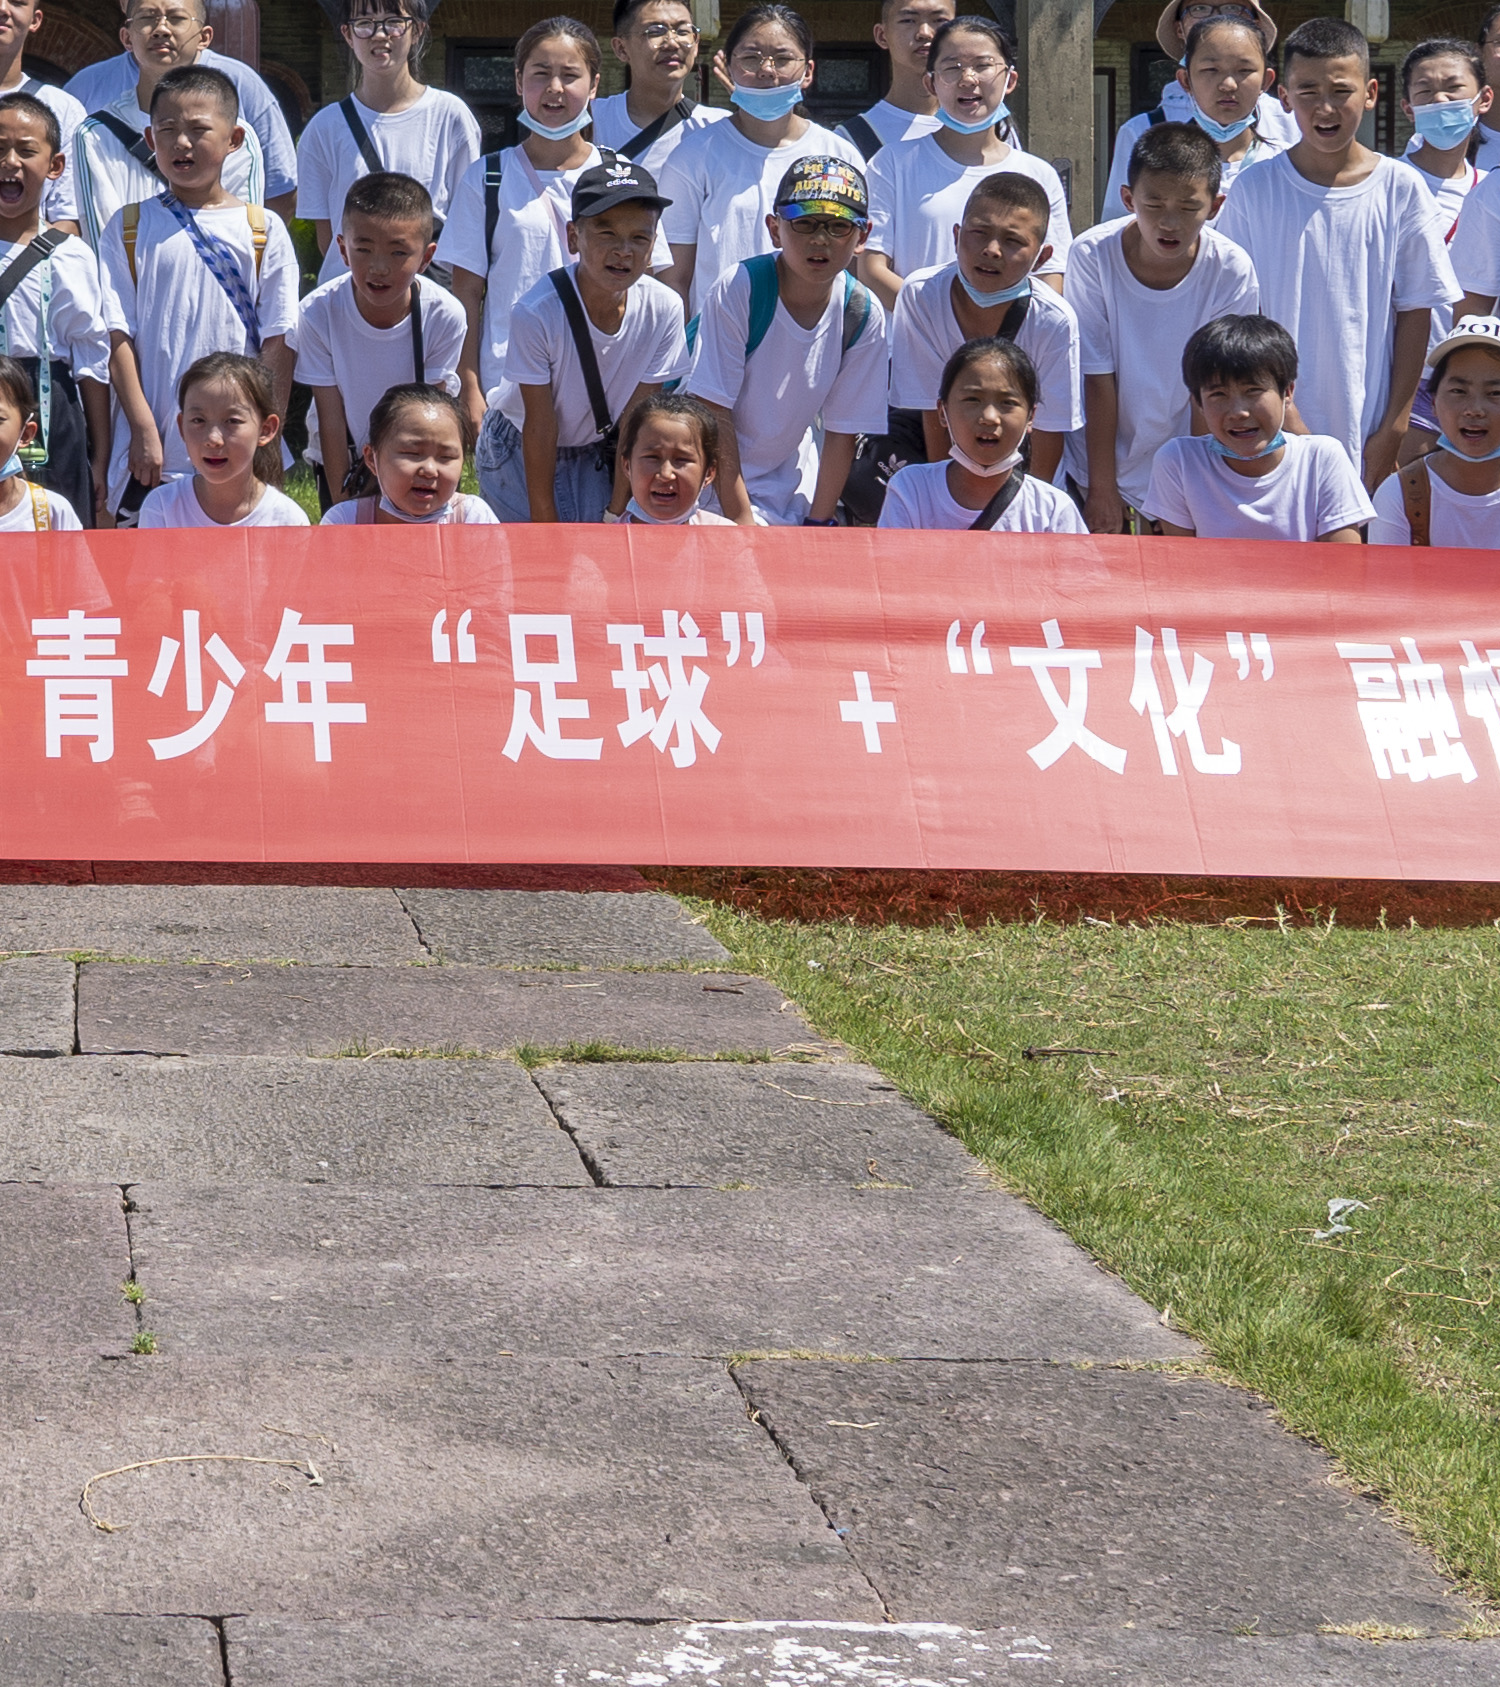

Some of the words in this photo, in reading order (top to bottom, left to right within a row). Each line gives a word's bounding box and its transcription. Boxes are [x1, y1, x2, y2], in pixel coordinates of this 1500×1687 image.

[25, 608, 368, 764] 青少年
[431, 607, 766, 769] “足球”
[838, 670, 898, 754] +
[946, 618, 1276, 776] “文化”
